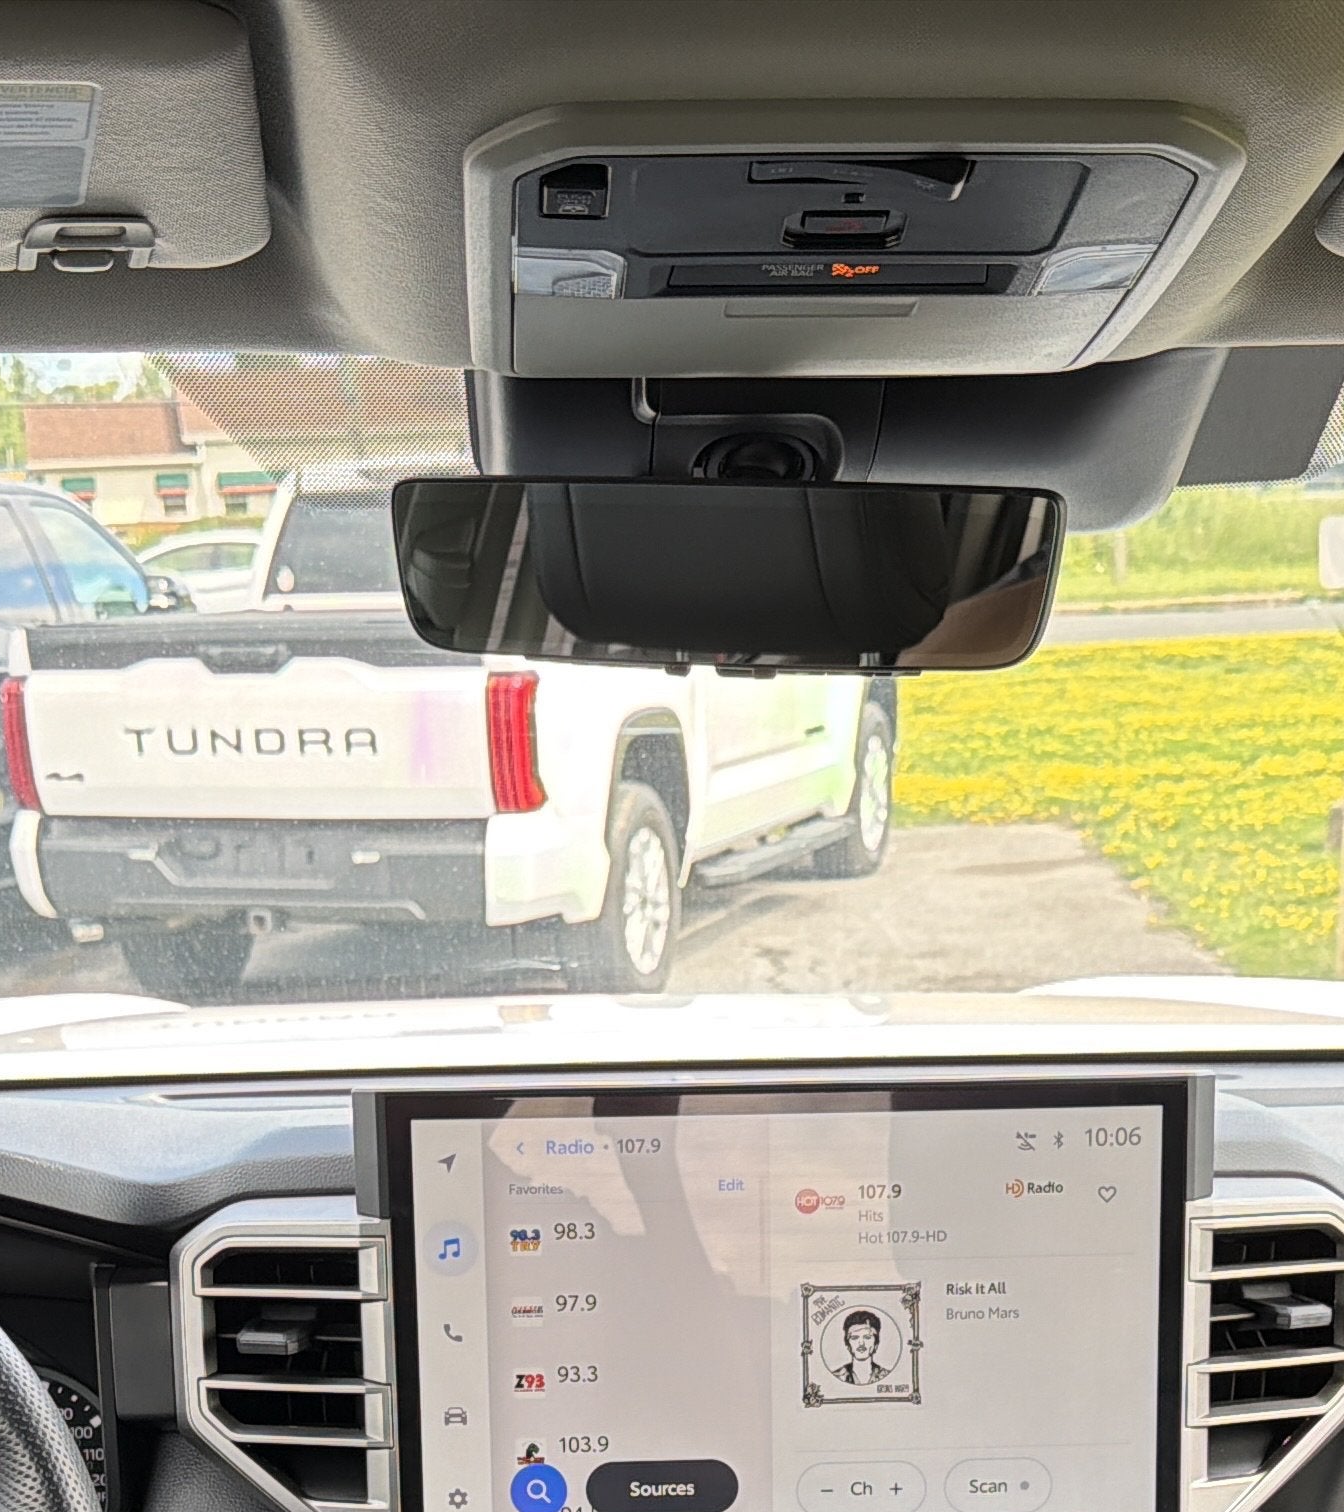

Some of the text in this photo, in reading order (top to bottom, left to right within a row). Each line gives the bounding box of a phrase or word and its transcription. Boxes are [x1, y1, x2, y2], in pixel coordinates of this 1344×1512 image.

[854, 265, 880, 274] OFF
[124, 727, 379, 756] TUNDRA
[1084, 1126, 1143, 1148] 10:06
[546, 1138, 662, 1155] Radio 107.9
[508, 1183, 565, 1196] Favorites
[717, 1178, 745, 1192] Edit
[858, 1183, 903, 1200] 107.9
[1027, 1180, 1064, 1195] Radio
[858, 1209, 885, 1223] Hits
[553, 1222, 596, 1241] 98.3
[858, 1229, 948, 1245] Hot 107.9-HD
[946, 1281, 1008, 1296] Risk It All
[556, 1294, 598, 1312] 97.9
[946, 1305, 1021, 1321] Bruno Mars
[514, 1373, 546, 1389] Z93
[557, 1366, 599, 1383] 93.3
[558, 1435, 610, 1454] 103.9
[83, 1448, 105, 1461] 110
[629, 1480, 696, 1498] Sources
[850, 1480, 873, 1496] Ch
[968, 1478, 1009, 1495] Scan
